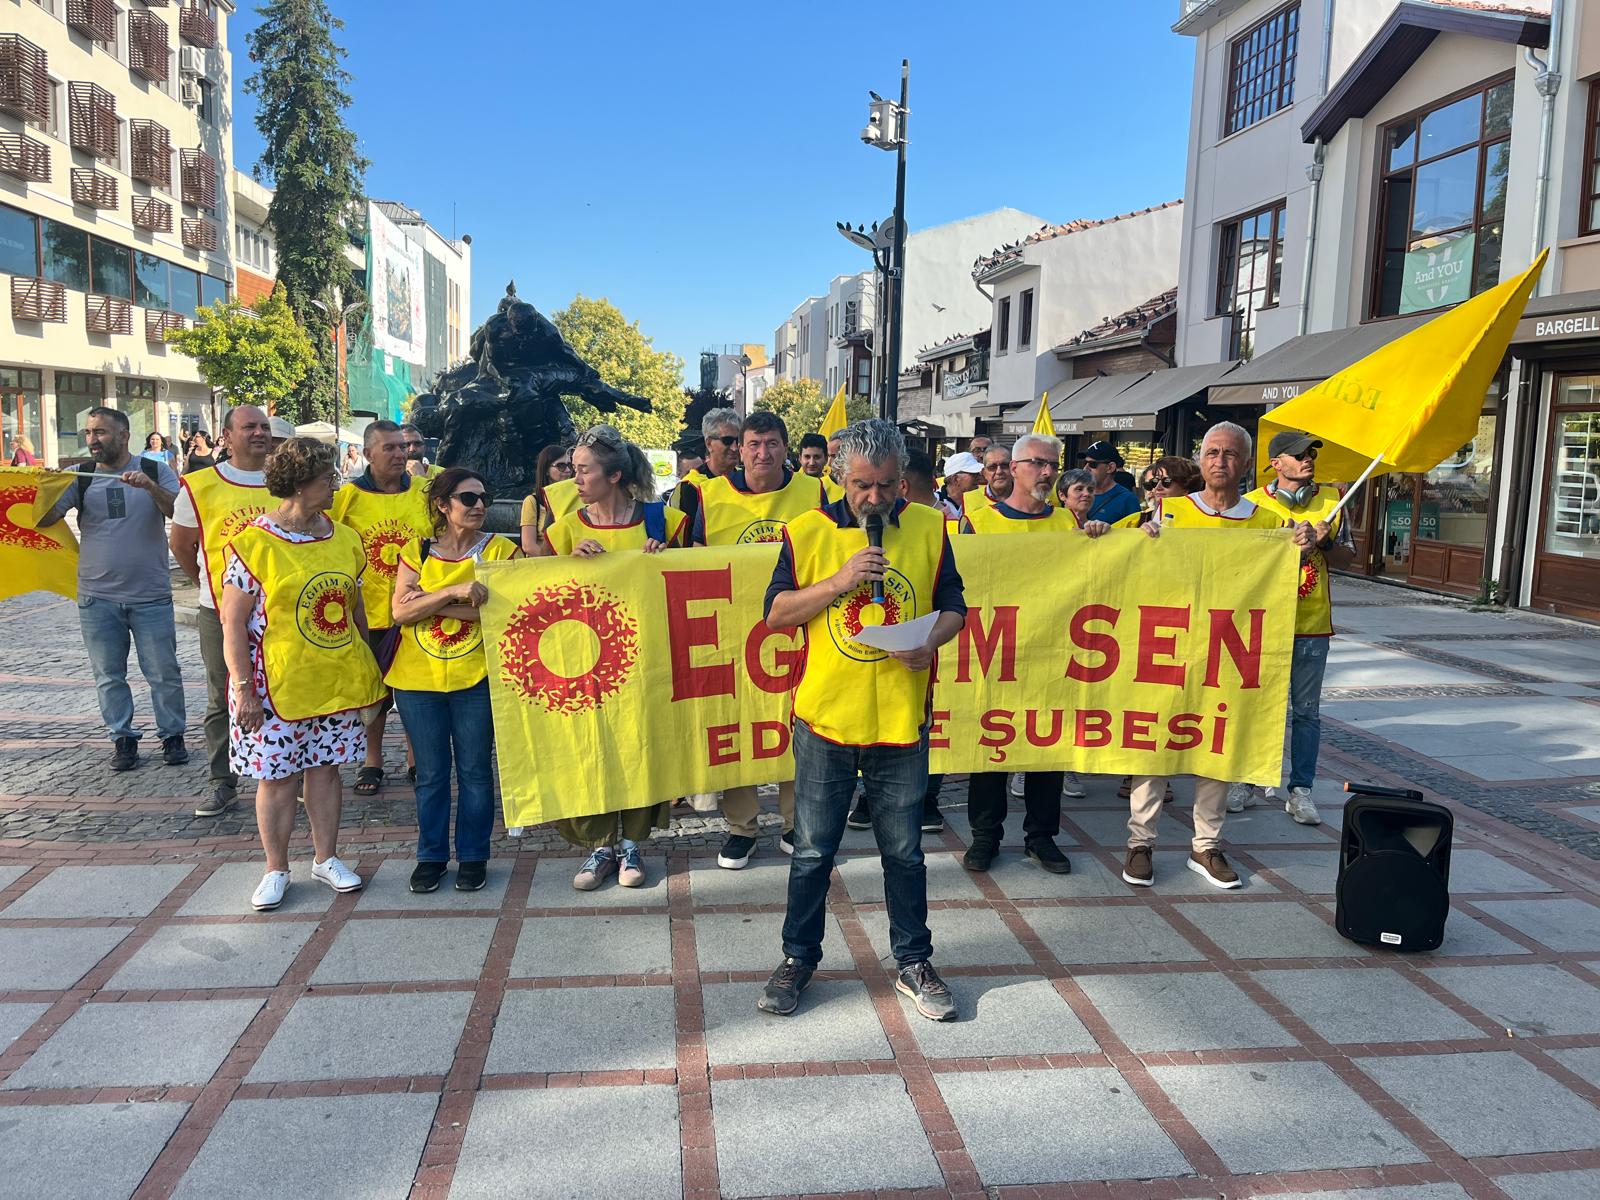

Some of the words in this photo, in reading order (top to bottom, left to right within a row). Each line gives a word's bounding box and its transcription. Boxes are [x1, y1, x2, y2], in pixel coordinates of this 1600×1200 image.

[1414, 267, 1435, 285] And
[1437, 259, 1463, 278] YOU
[1262, 387, 1279, 400] AND
[1282, 386, 1299, 399] YOU
[219, 504, 266, 537] EĞİTİM
[744, 525, 774, 544] ĞİTİM
[301, 577, 340, 609] EĞİTİM
[885, 576, 911, 602] SEN
[1064, 603, 1267, 692] SEN
[978, 702, 1229, 763] ŞUBESİ
